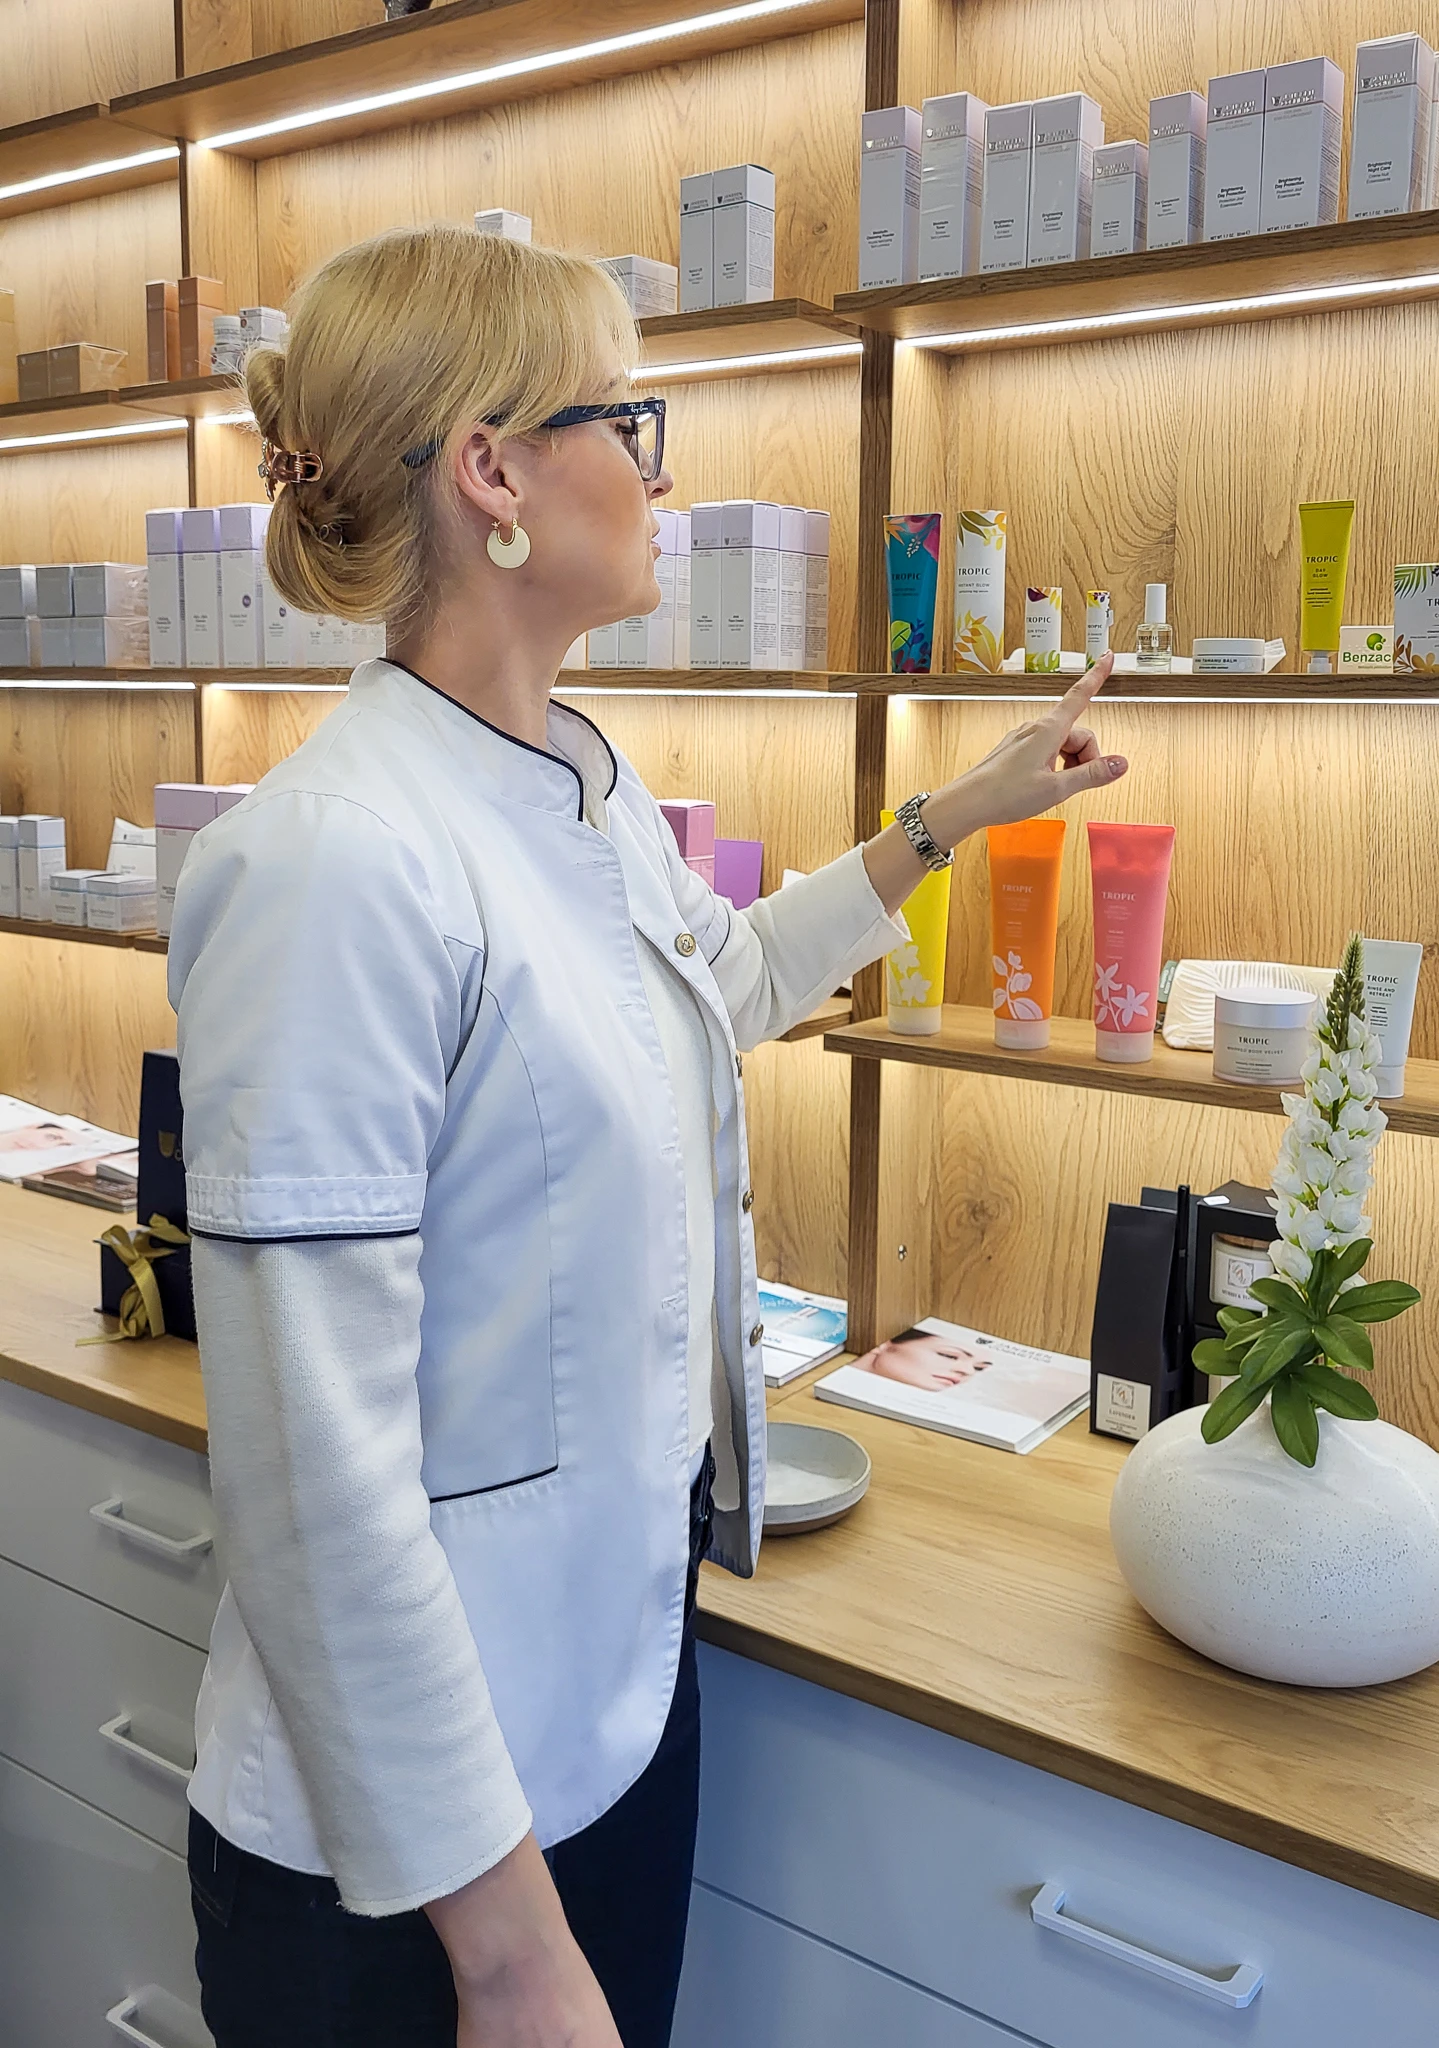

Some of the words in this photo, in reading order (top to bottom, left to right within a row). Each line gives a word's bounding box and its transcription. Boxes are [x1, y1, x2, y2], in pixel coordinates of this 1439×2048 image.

[958, 568, 991, 576] TROPIC
[1342, 652, 1391, 662] Benzac
[1002, 884, 1033, 893] TROPIC
[1102, 892, 1136, 902] TROPIC
[1367, 975, 1399, 984] TROPIC
[1239, 1036, 1270, 1045] TROPIC
